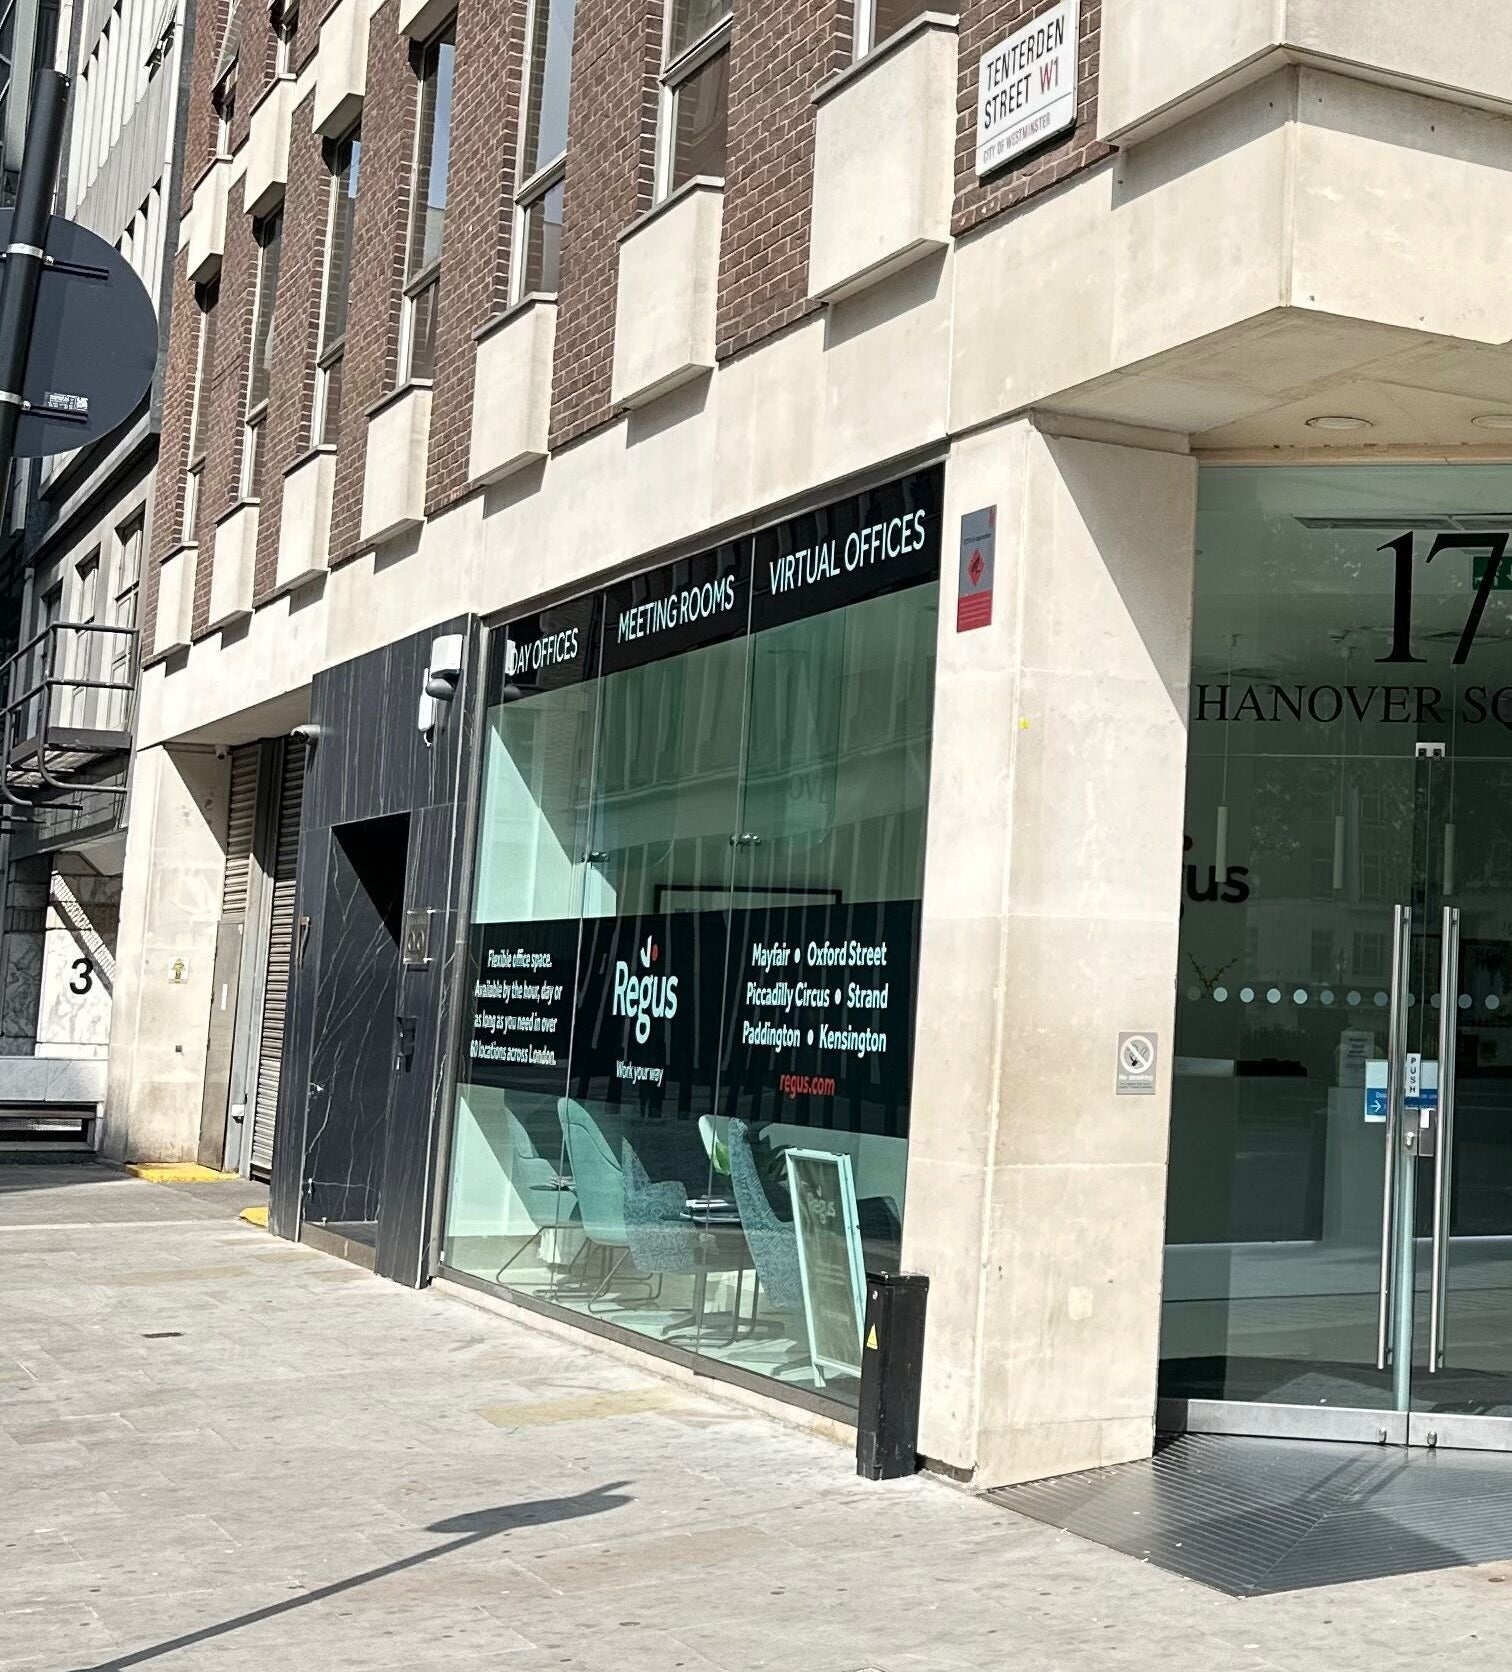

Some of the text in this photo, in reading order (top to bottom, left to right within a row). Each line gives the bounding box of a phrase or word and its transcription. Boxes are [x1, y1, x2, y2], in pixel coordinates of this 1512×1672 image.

[986, 14, 1065, 91] TENTERDEN
[984, 56, 1059, 129] STREET W1
[1006, 112, 1050, 149] WESTMINSTER
[769, 509, 926, 595] VIRTUAL OFFICES
[617, 575, 735, 644] MEETING ROOMS
[1374, 530, 1510, 666] 17
[509, 627, 579, 676] DAY OFFICES
[1195, 684, 1449, 724] HANOVER
[487, 948, 553, 973] Flexible office space.
[751, 940, 888, 973] Mayfair Oxford Street
[69, 957, 94, 995] 3
[475, 979, 563, 1006] Available by the hour, day or
[612, 961, 679, 1045] Regus
[745, 981, 889, 1014] Piccadilly Circus Strand
[474, 1009, 558, 1035] as long as you need in over
[742, 1020, 887, 1058] Paddington Kensington
[478, 1039, 507, 1061] locations
[506, 1045, 529, 1063] across
[529, 1043, 557, 1066] London.
[616, 1060, 664, 1088] Work your way
[779, 1073, 836, 1099] regus.com
